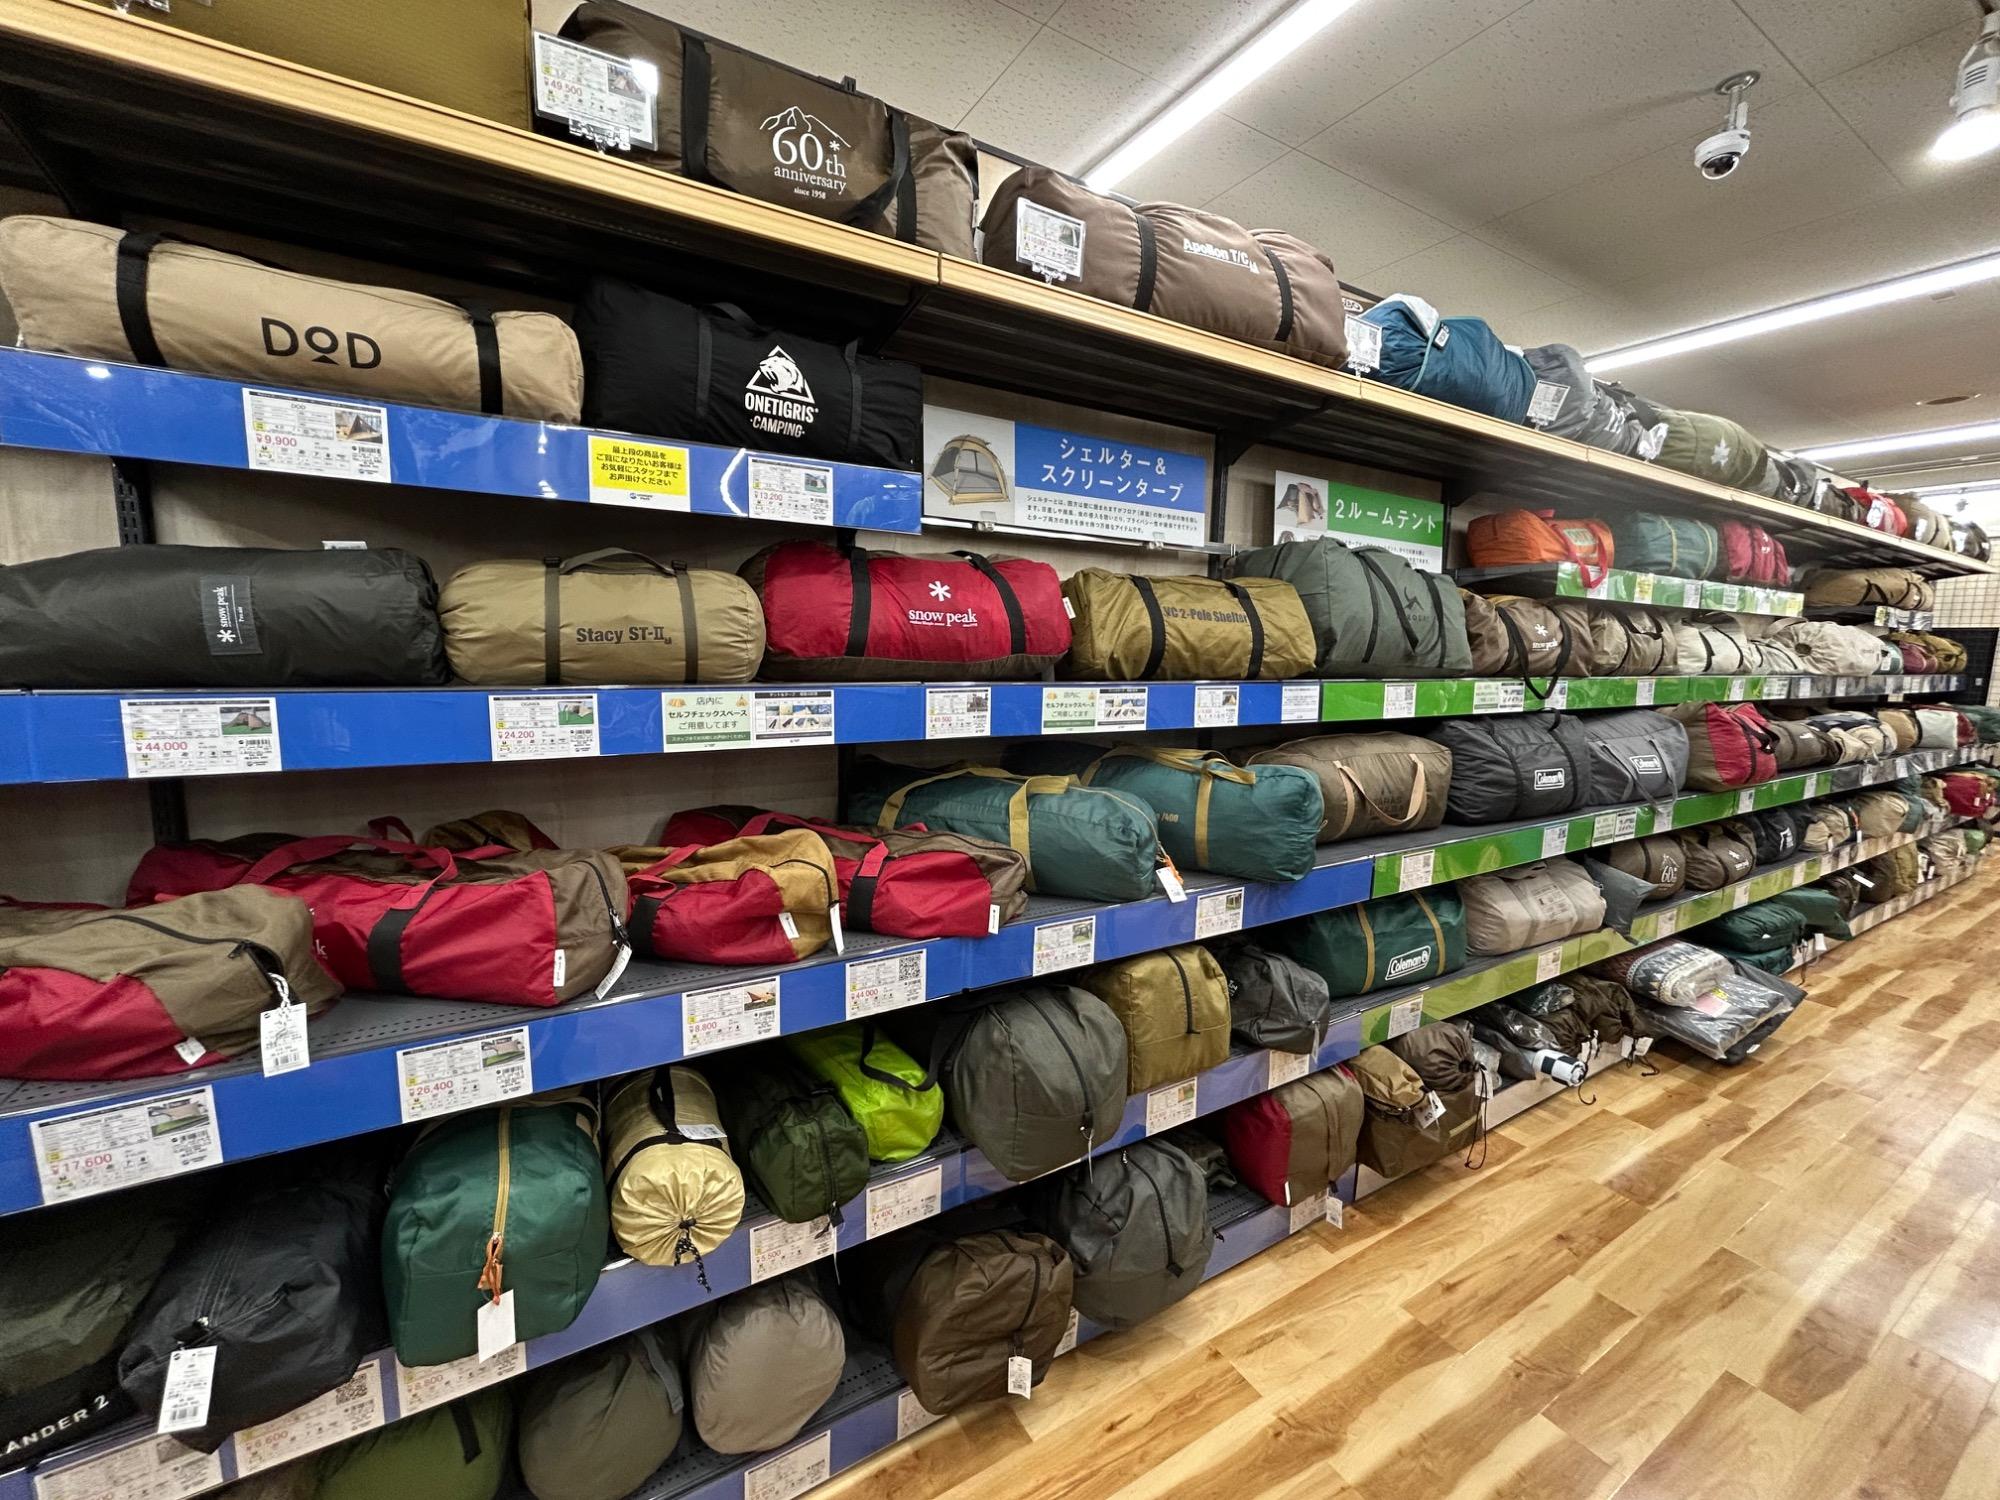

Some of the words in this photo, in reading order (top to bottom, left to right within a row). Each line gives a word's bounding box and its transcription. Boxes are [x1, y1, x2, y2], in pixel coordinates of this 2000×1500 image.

[773, 127, 846, 178] 60th
[774, 166, 847, 195] anniversary
[794, 187, 810, 196] since
[811, 190, 826, 200] 1958
[1183, 238, 1230, 261] Apollon
[1229, 249, 1249, 265] T/C
[261, 317, 381, 369] DOD
[745, 392, 814, 424] ONETIGRIS
[752, 415, 803, 438] CAMPING
[596, 453, 682, 470] ご覧になりたいお客様は
[612, 446, 667, 460] 最上段の商品を
[601, 463, 679, 479] お気軽にスタッフまで
[609, 473, 672, 486] お声掛けください
[1041, 464, 1184, 503] スクリーンタープ
[212, 586, 229, 605] peak
[218, 606, 228, 628] snow
[909, 609, 946, 622] snow
[946, 608, 978, 627] peak
[1212, 611, 1248, 623] Shelter
[576, 627, 624, 644] Stacy
[696, 696, 723, 706] 店内に
[668, 709, 748, 719] セルフチェックスペース
[678, 720, 739, 730] ご用意してます
[1391, 956, 1422, 974] Coleman
[0, 1408, 89, 1456] ANDER
[94, 1394, 109, 1411] 2
